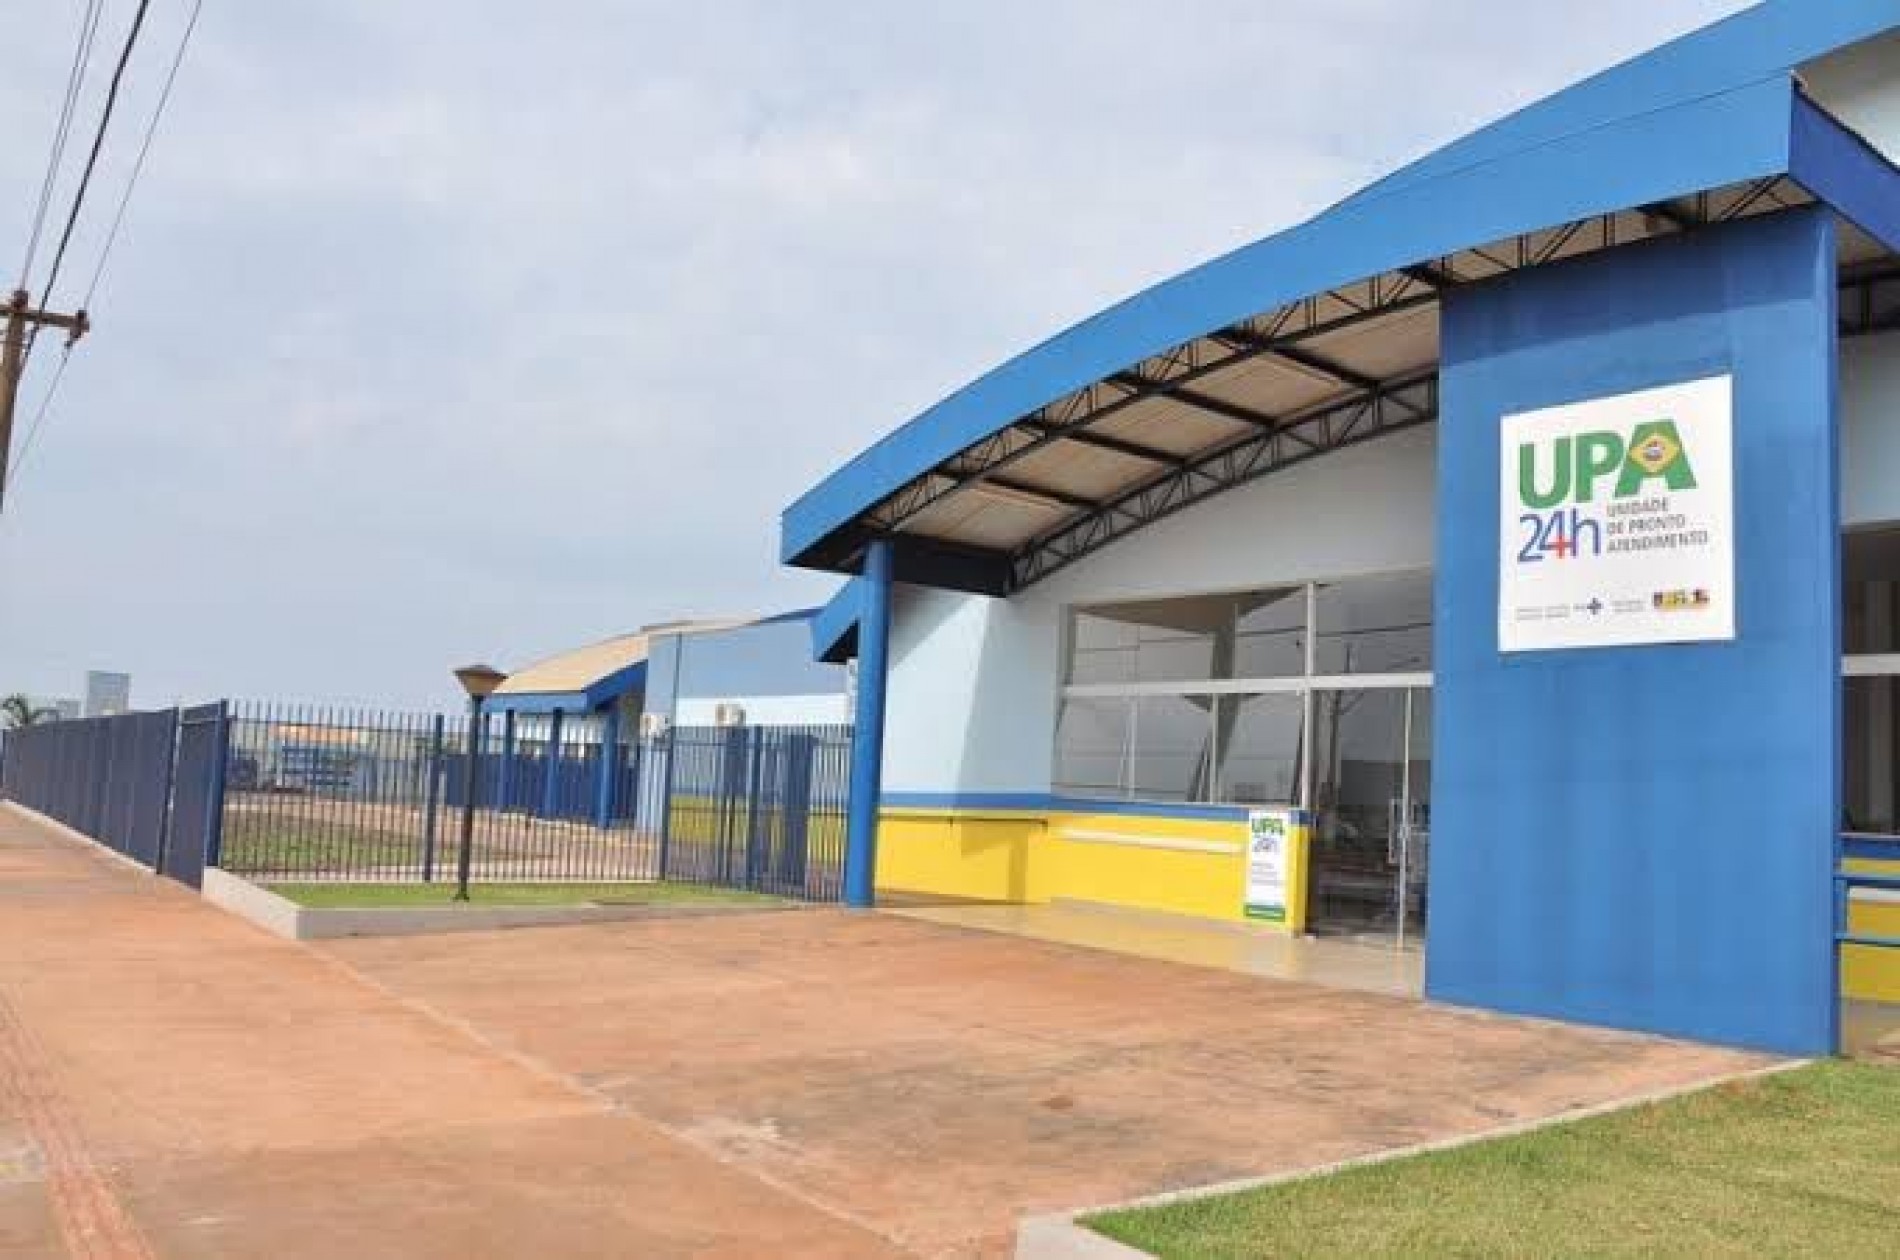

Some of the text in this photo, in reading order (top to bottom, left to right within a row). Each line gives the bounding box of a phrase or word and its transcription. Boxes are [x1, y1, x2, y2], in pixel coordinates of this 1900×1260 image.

[1519, 418, 1697, 508] UPA
[1607, 497, 1669, 517] UNIDADE
[1517, 508, 1601, 561] 24h
[1607, 514, 1686, 534] DE PRONTO
[1607, 530, 1708, 553] ATENDIMENTO
